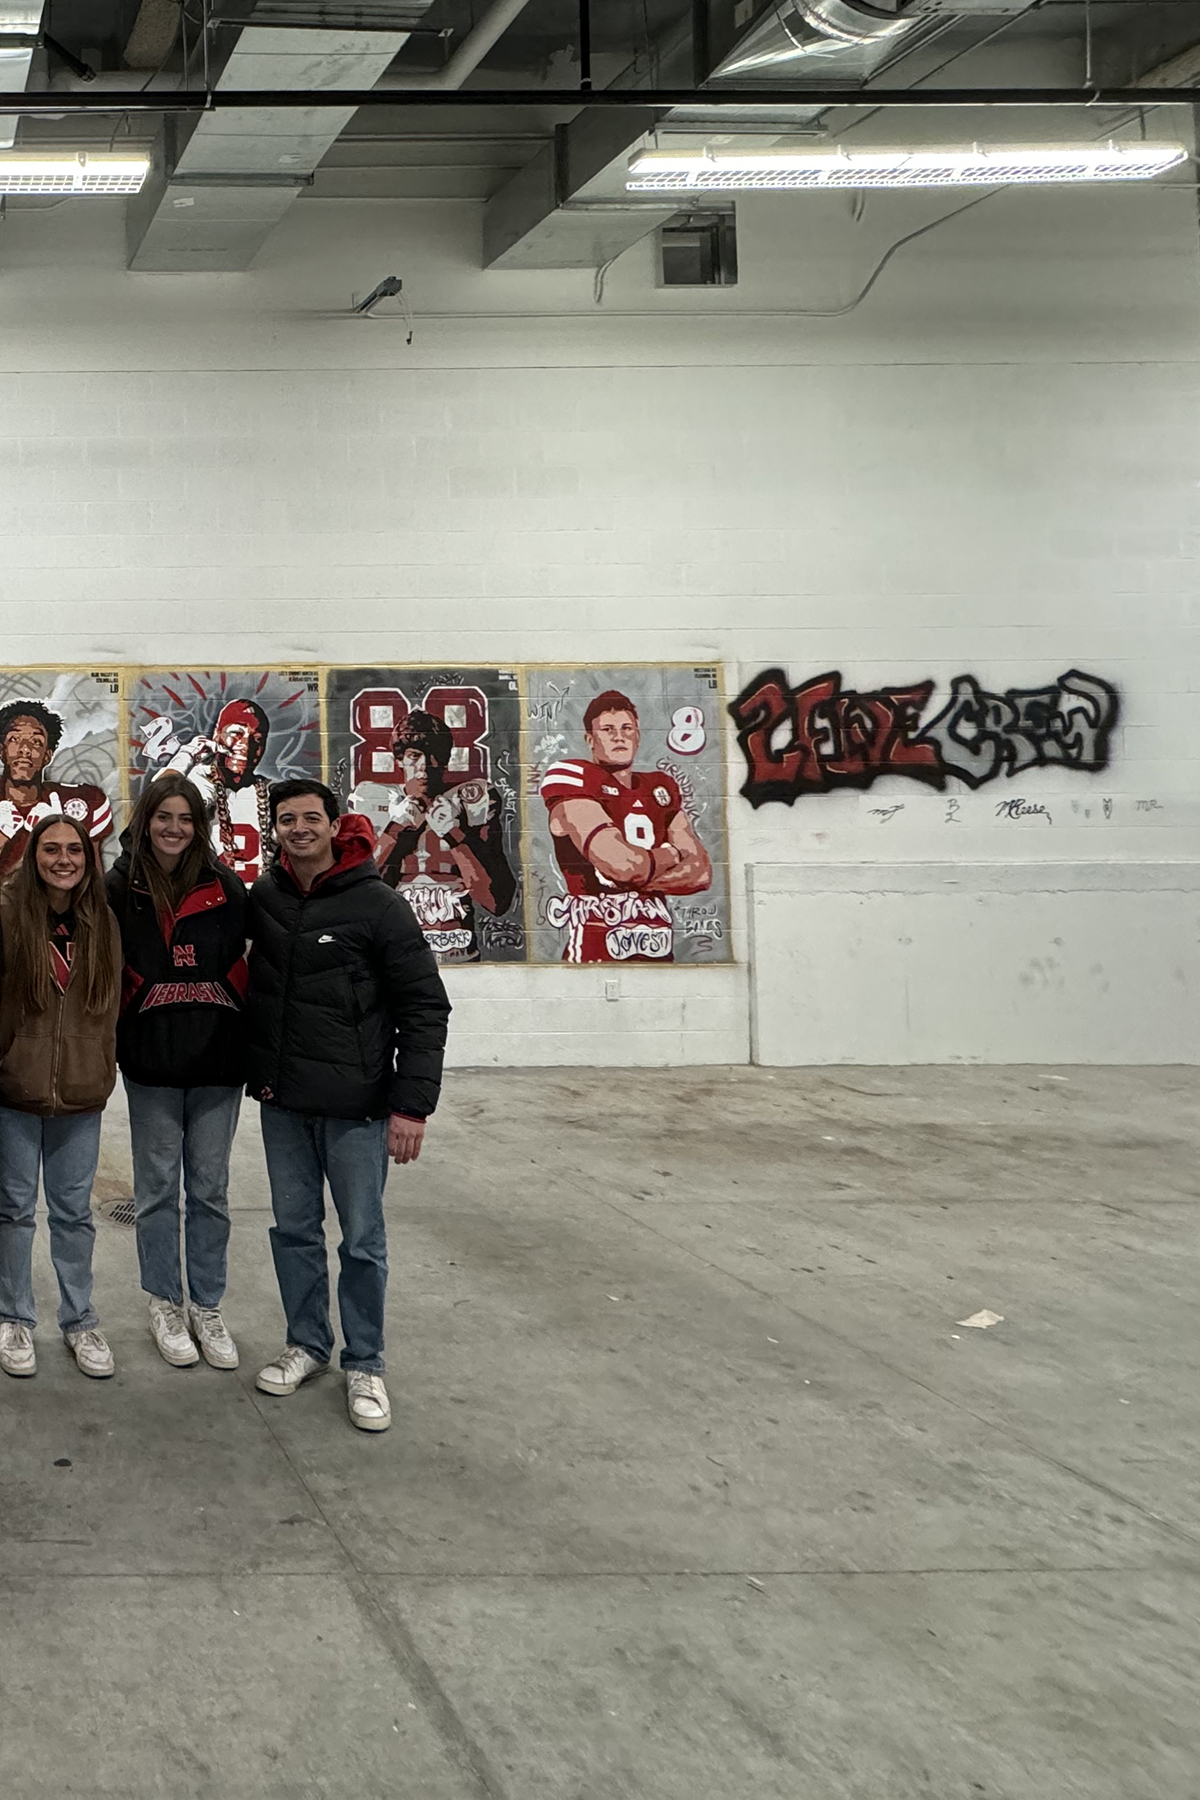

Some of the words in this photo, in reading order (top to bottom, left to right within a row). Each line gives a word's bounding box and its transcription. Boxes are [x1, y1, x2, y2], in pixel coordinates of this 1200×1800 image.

[110, 684, 119, 693] LB
[307, 683, 319, 692] WR
[139, 716, 180, 762] 2
[350, 686, 490, 790] 88
[666, 706, 707, 756] 8
[526, 762, 542, 796] LNK
[546, 891, 673, 929] CHRISTIAN
[173, 944, 196, 967] N
[138, 981, 241, 1013] NEBRASKA
